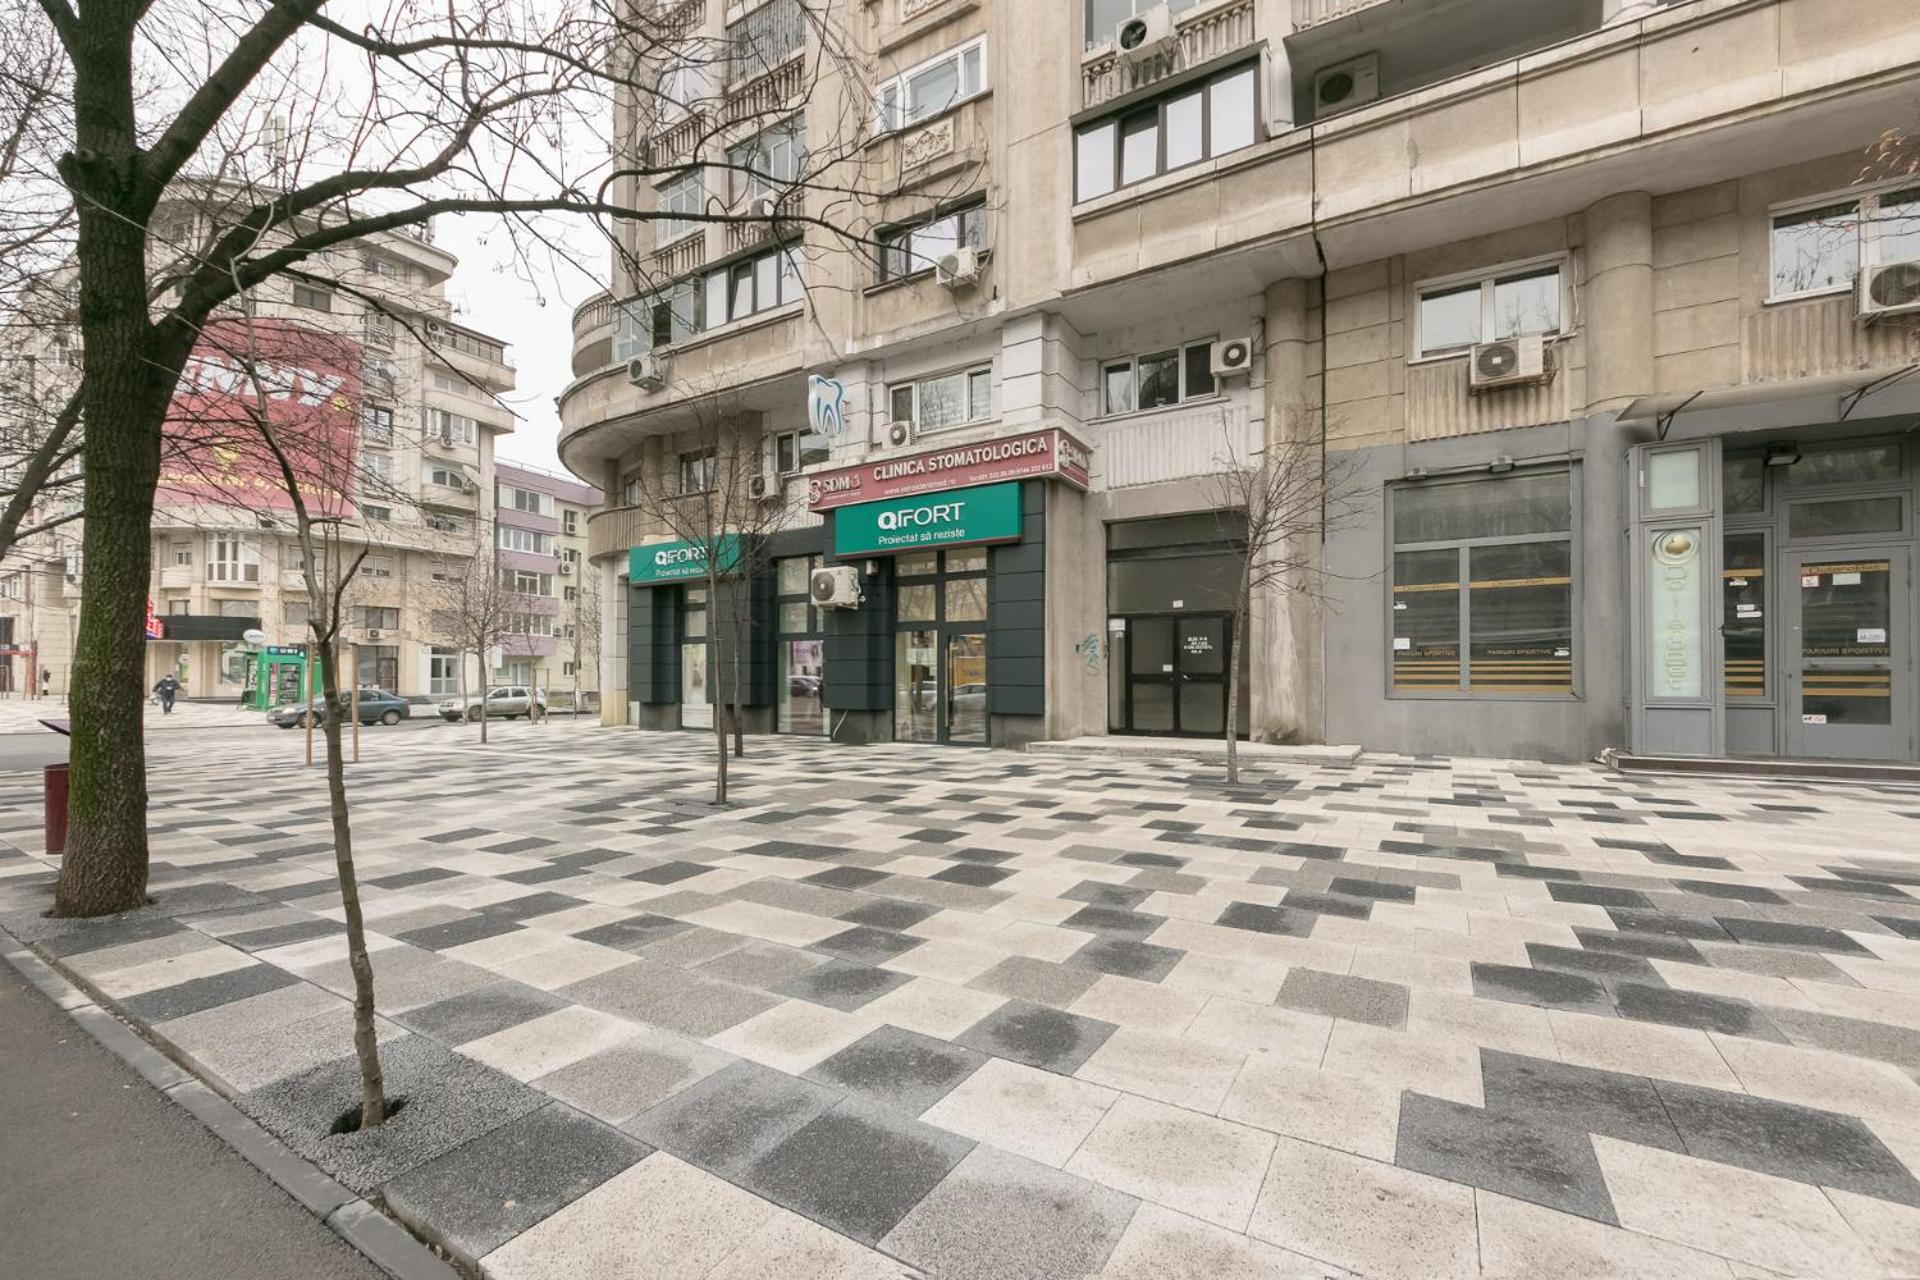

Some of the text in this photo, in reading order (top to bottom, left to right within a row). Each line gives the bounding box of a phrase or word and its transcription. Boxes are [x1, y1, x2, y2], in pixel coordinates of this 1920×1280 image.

[873, 458, 925, 481] CLINICA
[928, 437, 1049, 471] STOMATOLOGICA
[877, 503, 965, 530] QFORT
[878, 534, 918, 545] Proiectat
[934, 528, 965, 540] reziste
